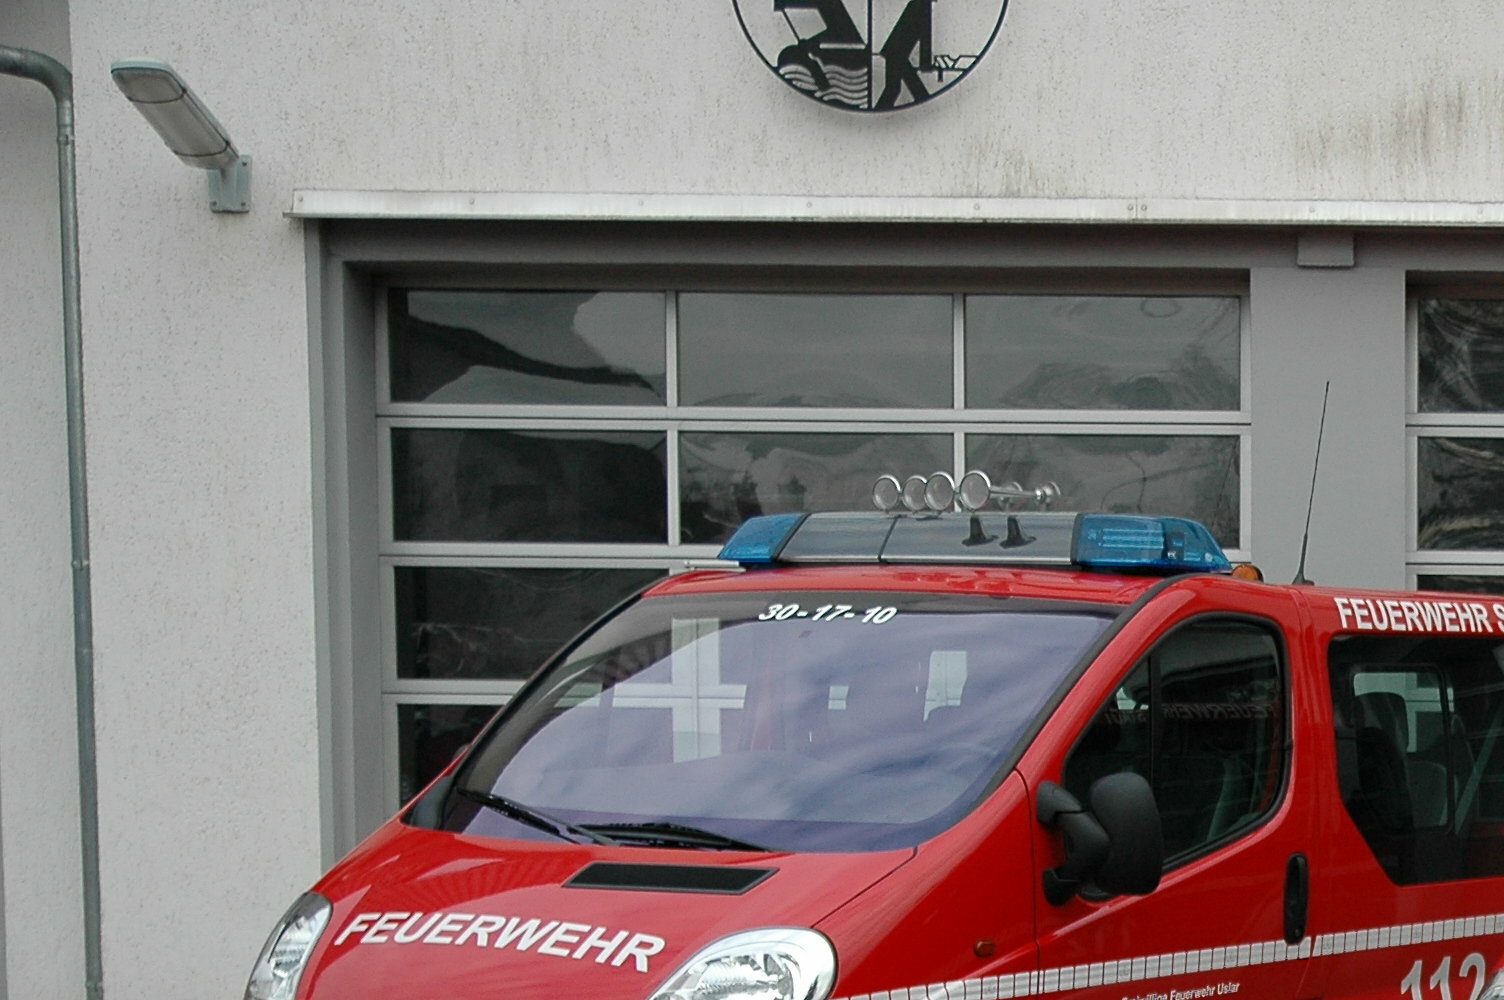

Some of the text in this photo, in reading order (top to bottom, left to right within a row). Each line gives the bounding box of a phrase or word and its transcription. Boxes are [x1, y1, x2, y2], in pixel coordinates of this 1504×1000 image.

[1334, 597, 1494, 633] FEUERWEHR
[334, 911, 667, 973] FEUERWEHR
[1217, 981, 1241, 995] Uslar
